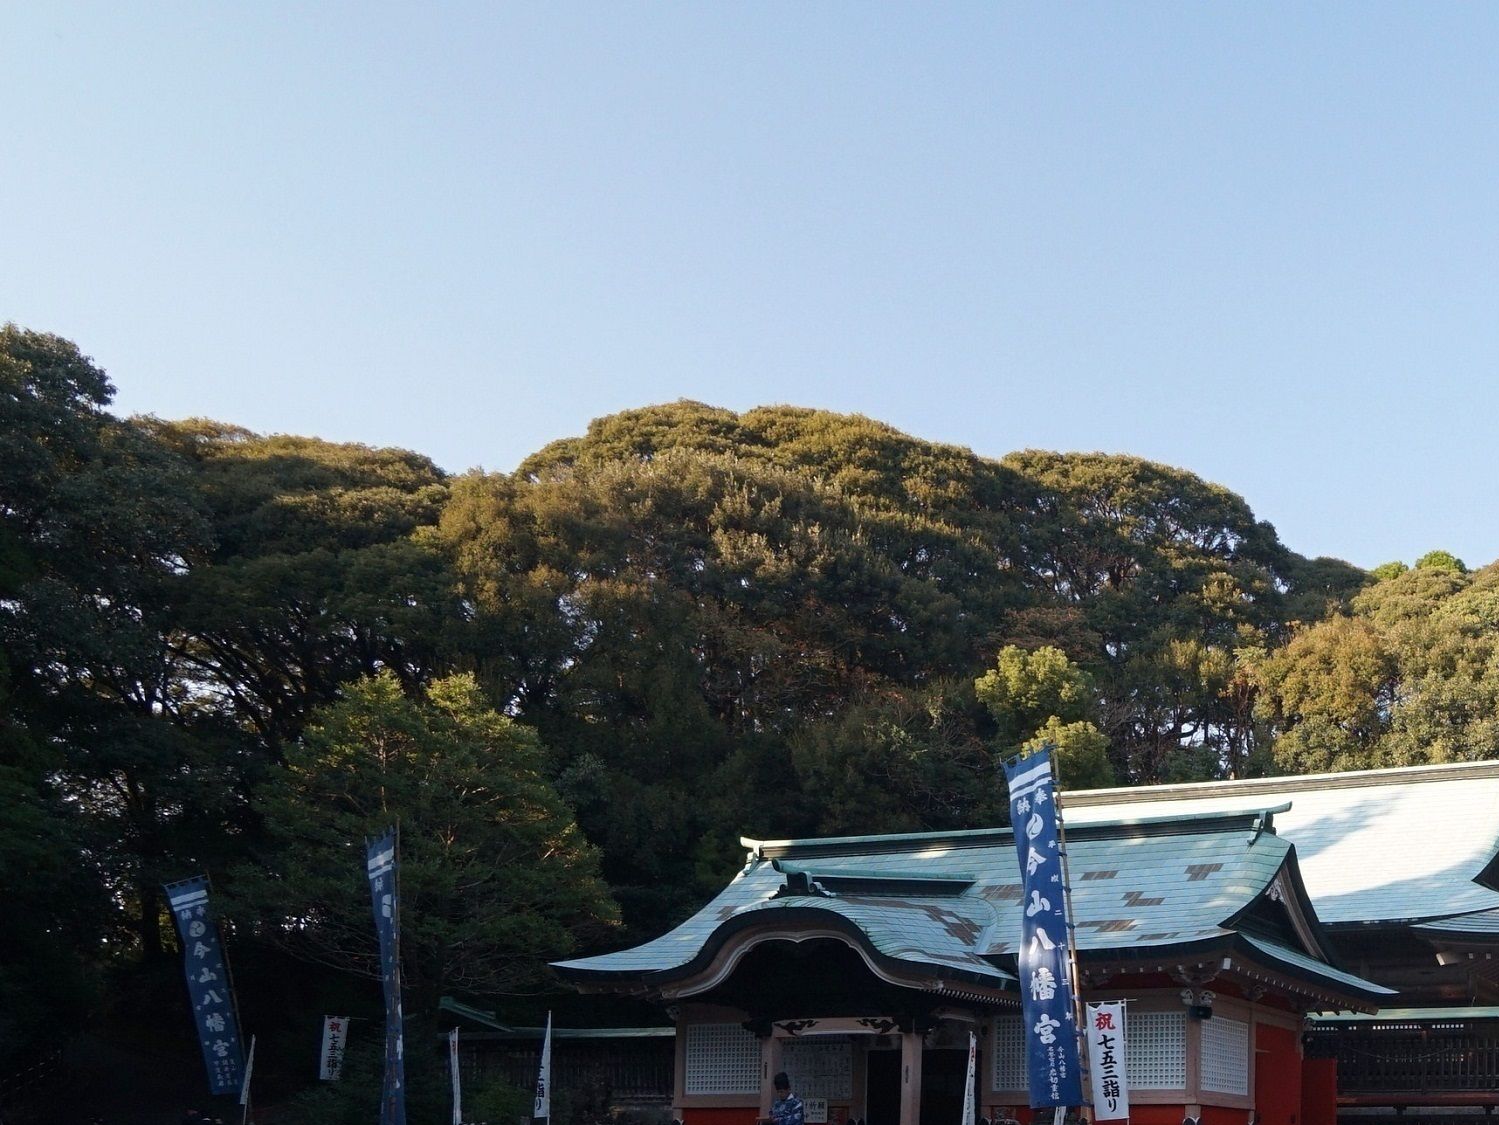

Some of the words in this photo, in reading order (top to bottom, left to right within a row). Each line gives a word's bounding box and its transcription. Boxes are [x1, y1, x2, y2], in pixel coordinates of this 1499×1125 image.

[1026, 846, 1061, 1045] 今山八幡宮
[192, 940, 230, 1057] 今山八幡宮
[328, 1022, 342, 1033] 祝
[1095, 1012, 1116, 1030] 祝
[327, 1034, 340, 1076] 七五三詣り
[1097, 1034, 1120, 1112] 七五三詣り
